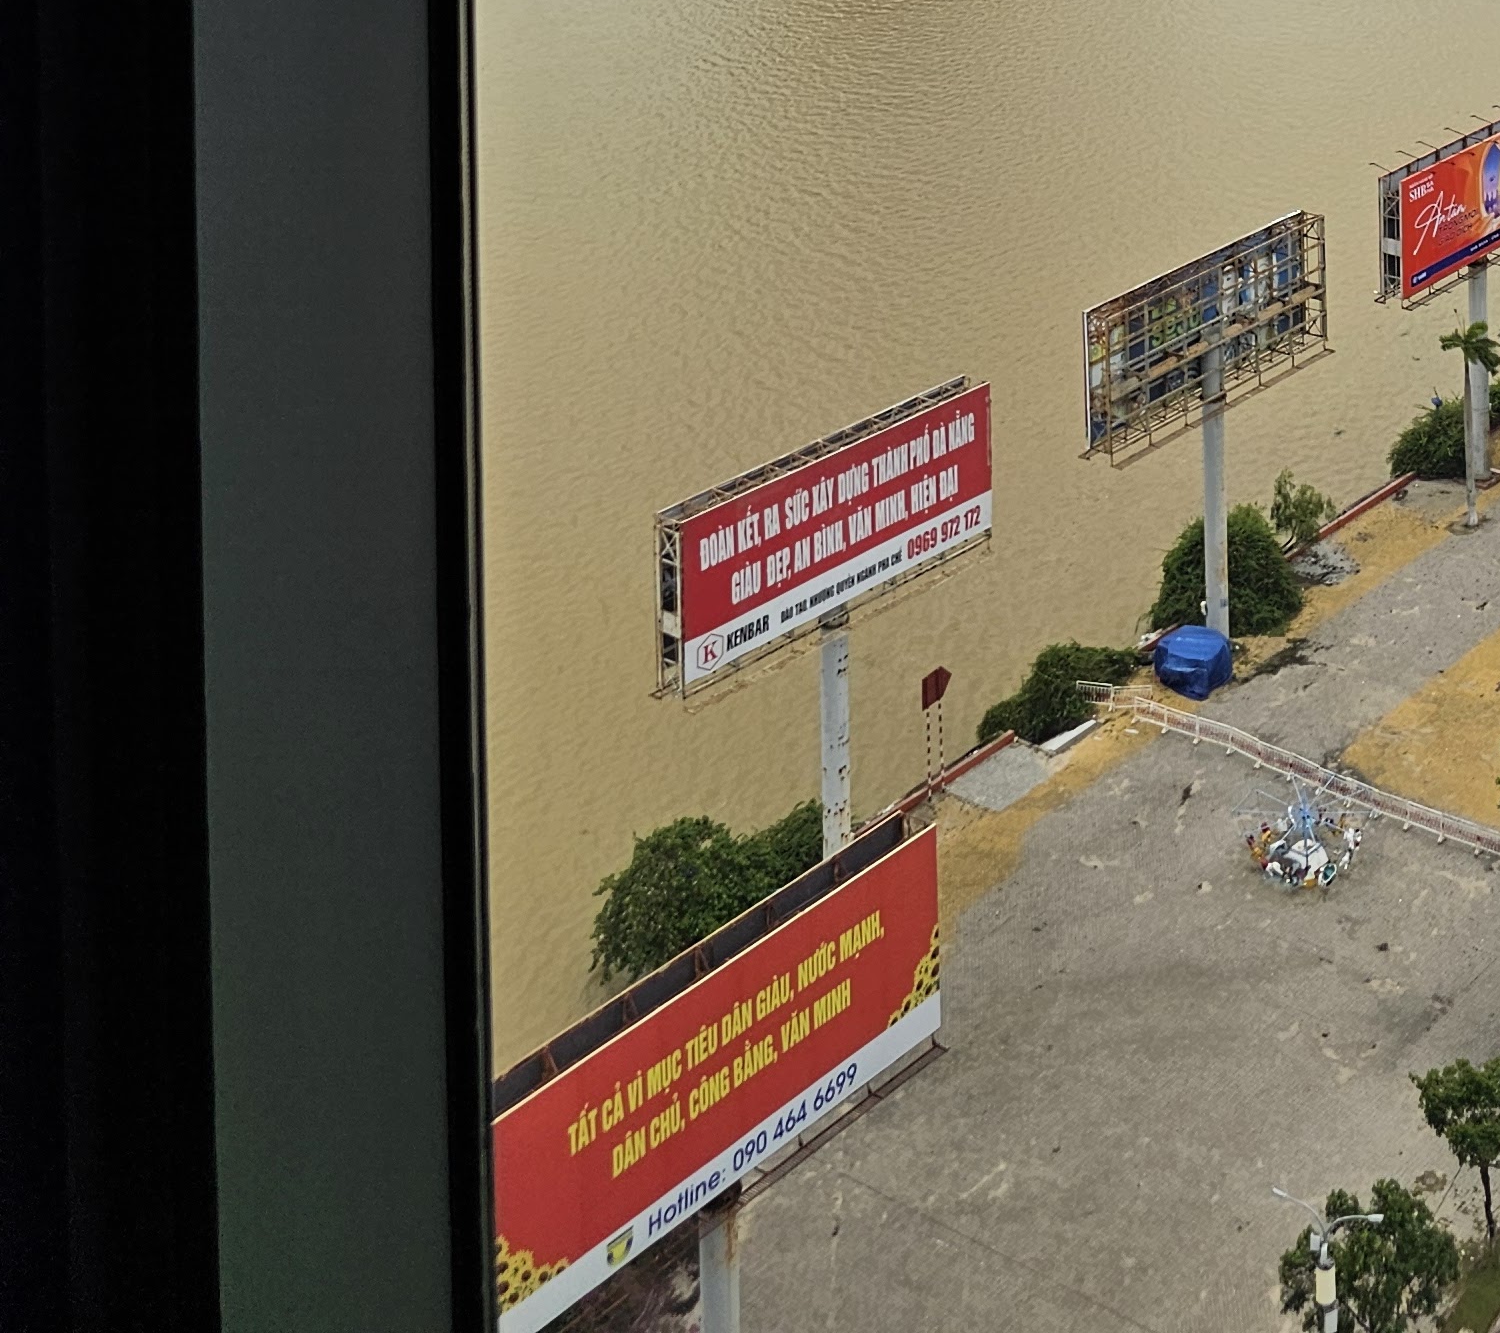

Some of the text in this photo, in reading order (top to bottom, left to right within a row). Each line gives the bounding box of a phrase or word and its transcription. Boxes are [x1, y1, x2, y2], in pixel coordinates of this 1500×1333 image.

[700, 524, 734, 572] ĐOÀN
[737, 505, 761, 553] KẾT,
[764, 503, 780, 540] RA
[784, 488, 809, 529] SỨC
[812, 476, 834, 517] XÂY
[838, 462, 869, 505] DỰNG
[872, 443, 908, 487] THÀNH
[910, 424, 930, 470] PHỐ
[731, 464, 958, 605] GIÀU ĐẸP, AN BÌNH, VĂN MINH, HIỆN ĐẠI
[907, 505, 981, 559] 0969 972 172
[703, 639, 718, 665] K
[726, 614, 769, 652] KENBAR
[568, 910, 884, 1156] TẤT CẢ VÌ MỤC TIÊU DÂN GIÀU, NƯỚC MẠNH,
[612, 978, 851, 1180] DÂN CHỦ, CÔNG BẰNG, VĂN MINH
[648, 1063, 857, 1236] Hotline: 090 464 6699
